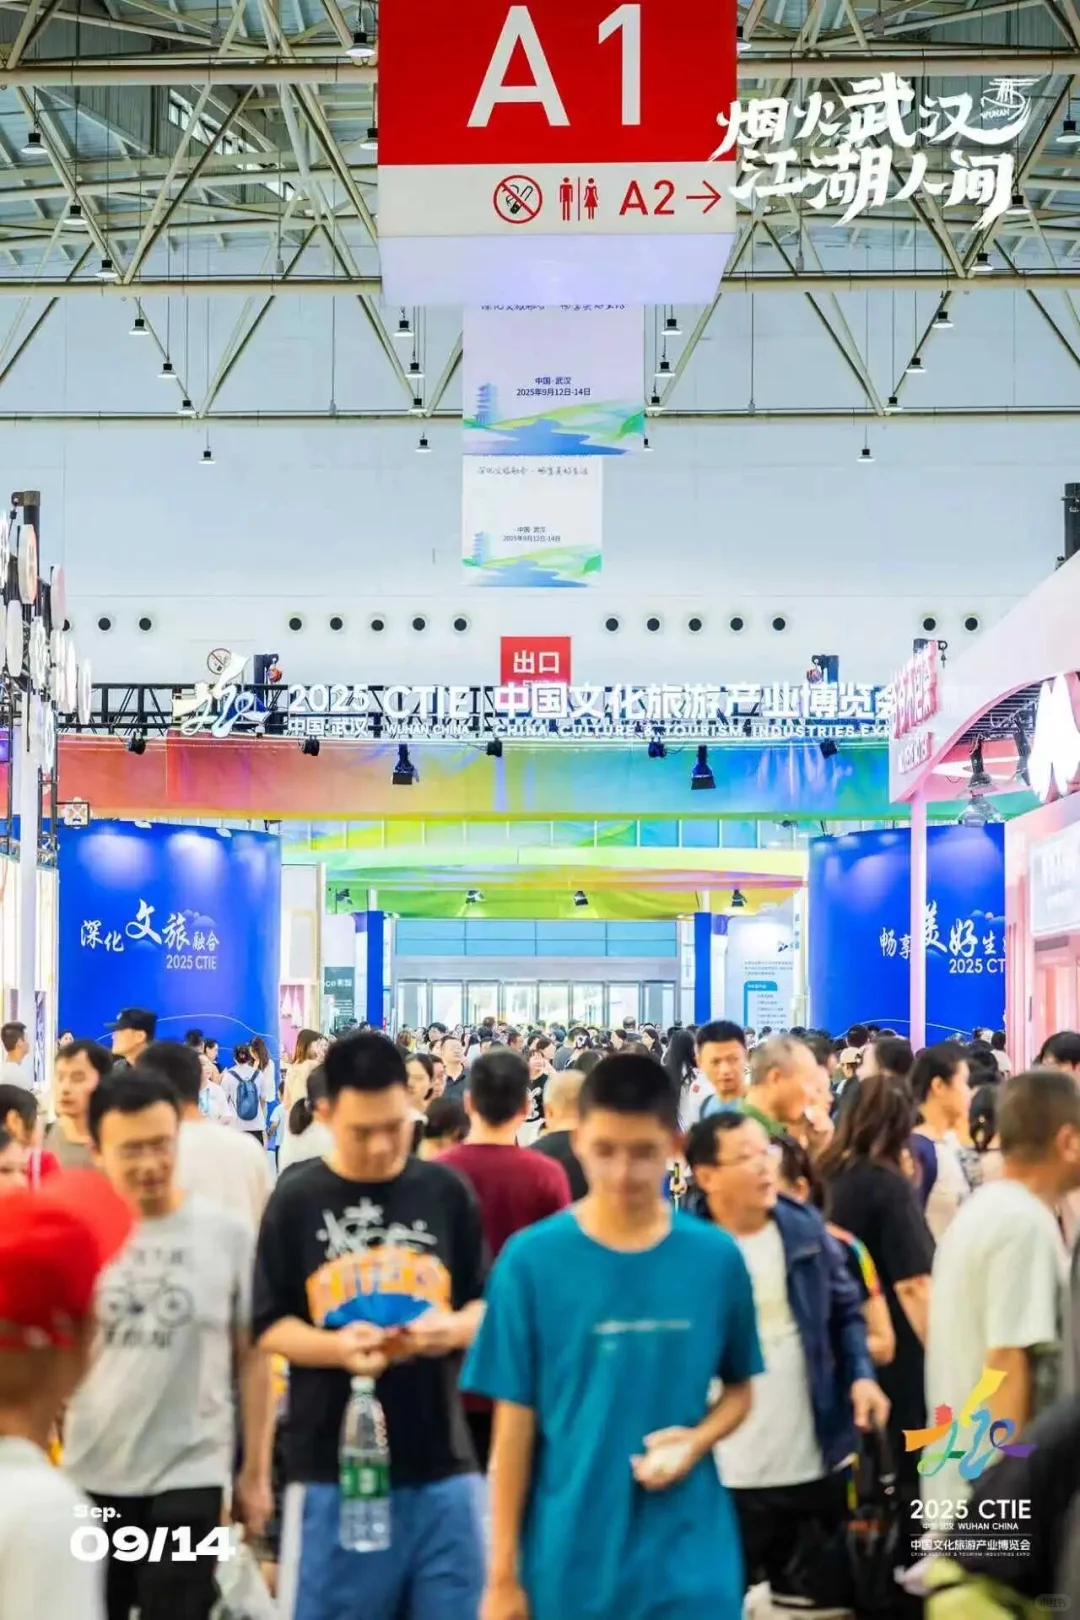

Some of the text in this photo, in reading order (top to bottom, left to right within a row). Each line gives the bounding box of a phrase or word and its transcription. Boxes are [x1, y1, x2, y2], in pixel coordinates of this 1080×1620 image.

[467, 4, 641, 127] A1
[619, 180, 675, 216] A2
[516, 387, 591, 396] 2025年9月12日-14日
[513, 650, 559, 673] 出口
[288, 681, 897, 720] 2025 CTIE 中国文化旅游产业博览会
[386, 724, 429, 735] WUHAN
[433, 724, 470, 735] CHINA
[559, 724, 635, 736] CULTURE
[666, 724, 743, 736] TOURISM
[753, 723, 855, 737] INDUSTRIES
[81, 898, 220, 952] 深化文旅融合
[166, 954, 217, 970] 2025 CTIE
[949, 958, 983, 973] 2025
